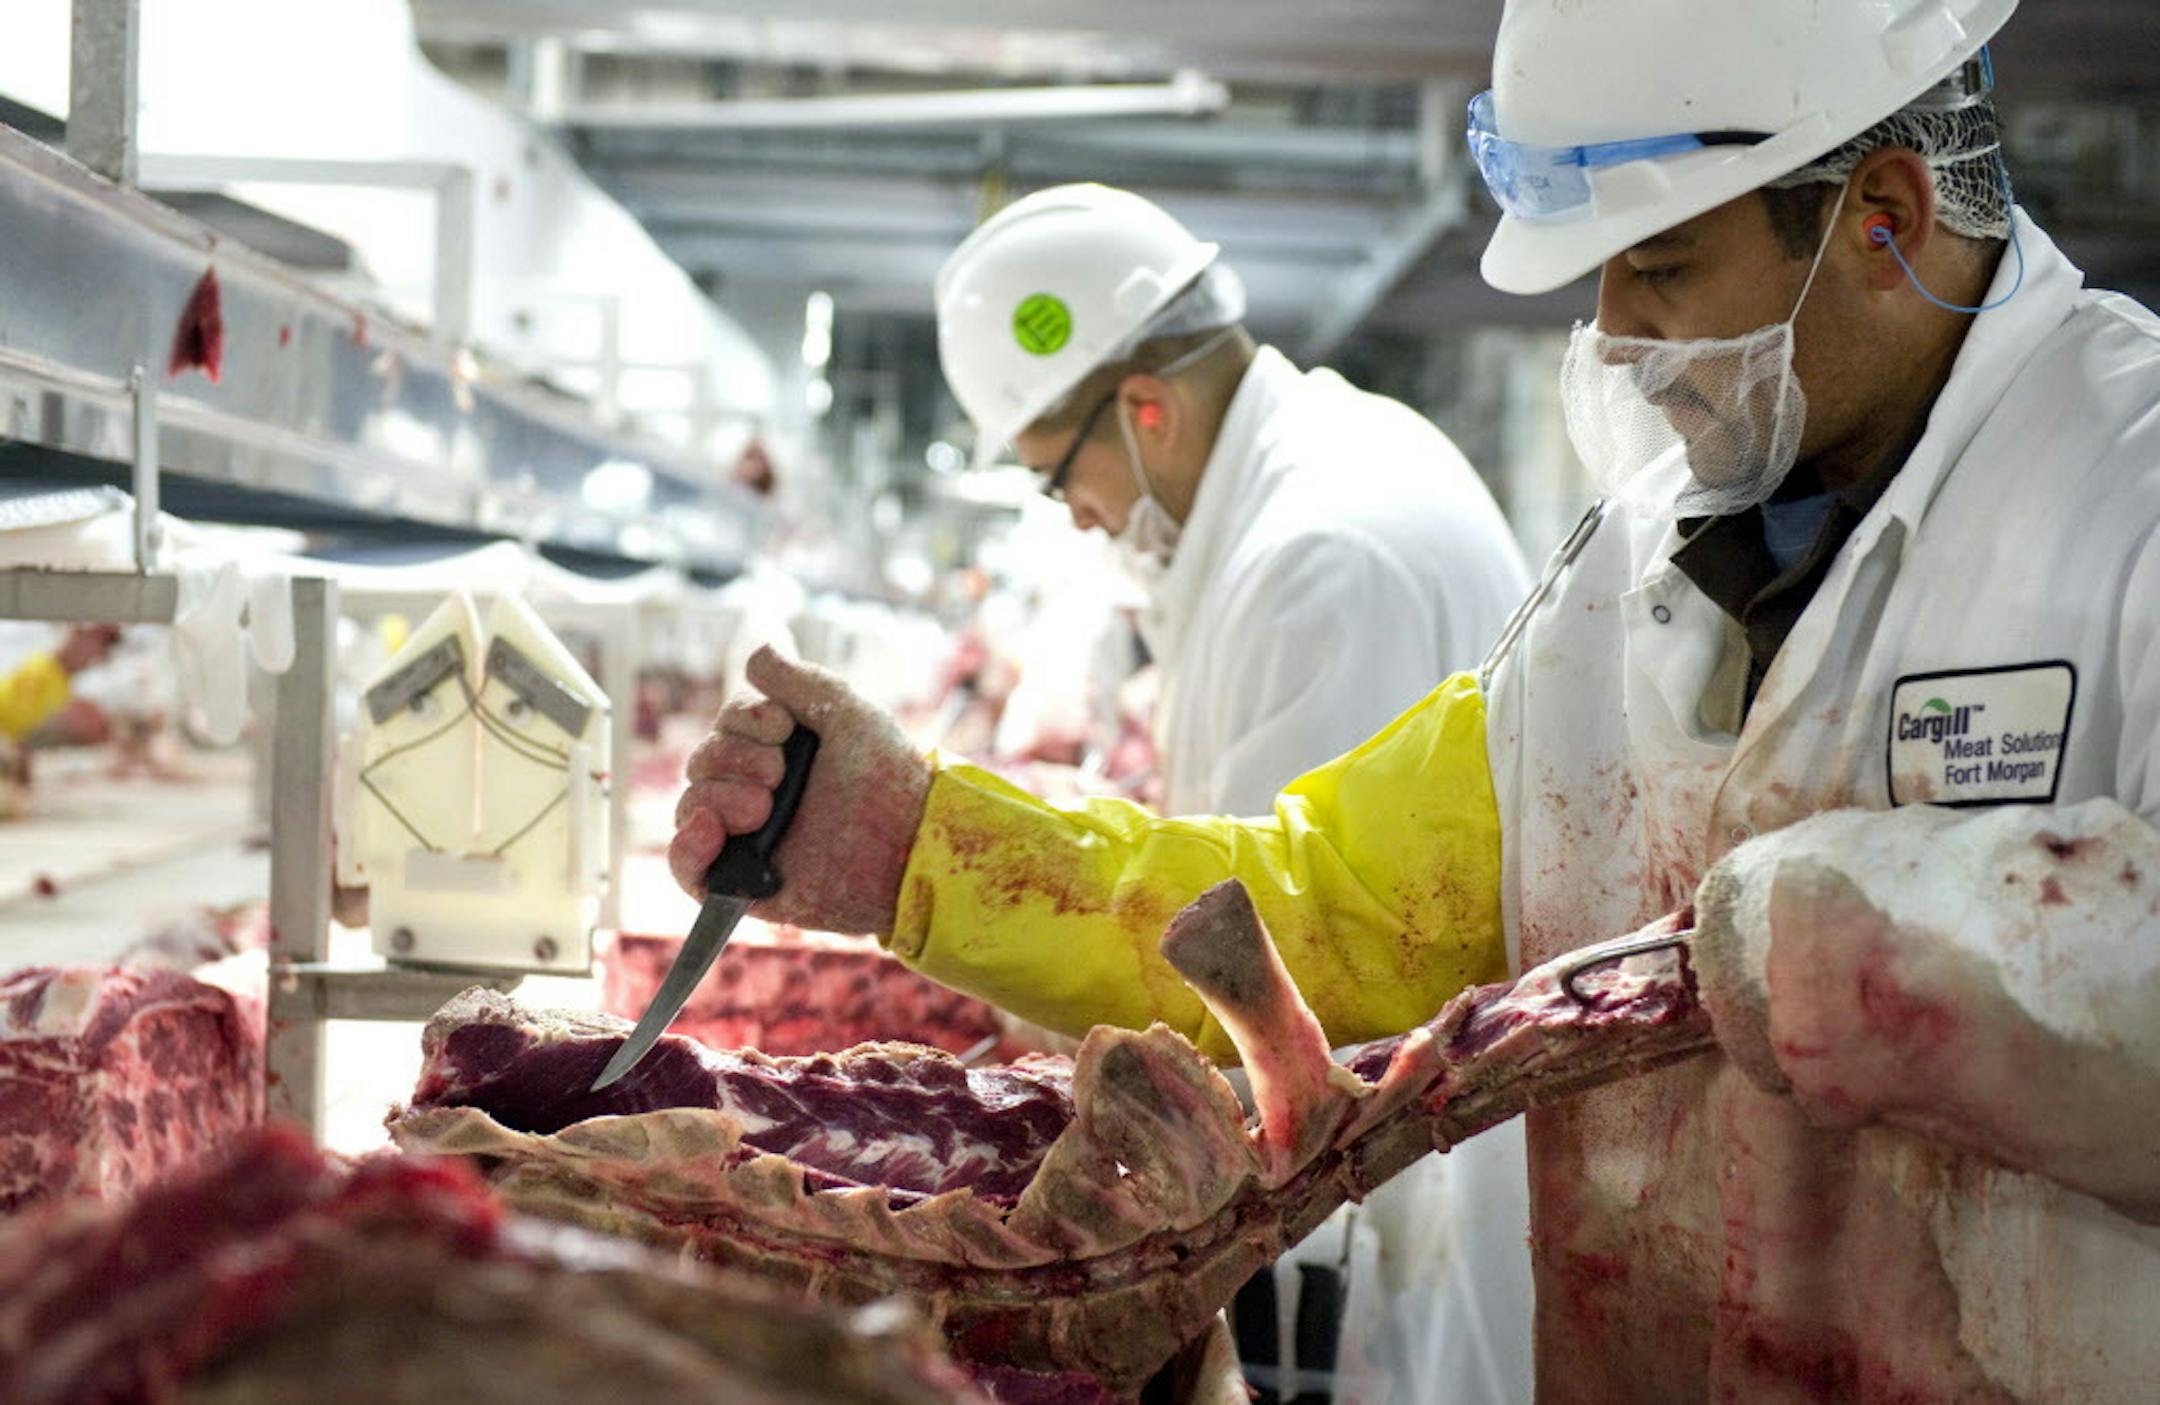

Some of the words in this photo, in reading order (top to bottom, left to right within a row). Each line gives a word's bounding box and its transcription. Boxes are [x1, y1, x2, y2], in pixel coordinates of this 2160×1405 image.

[1944, 739, 1993, 759] Meat
[1945, 764, 1982, 784] Fort
[1987, 761, 2045, 783] Morgan
